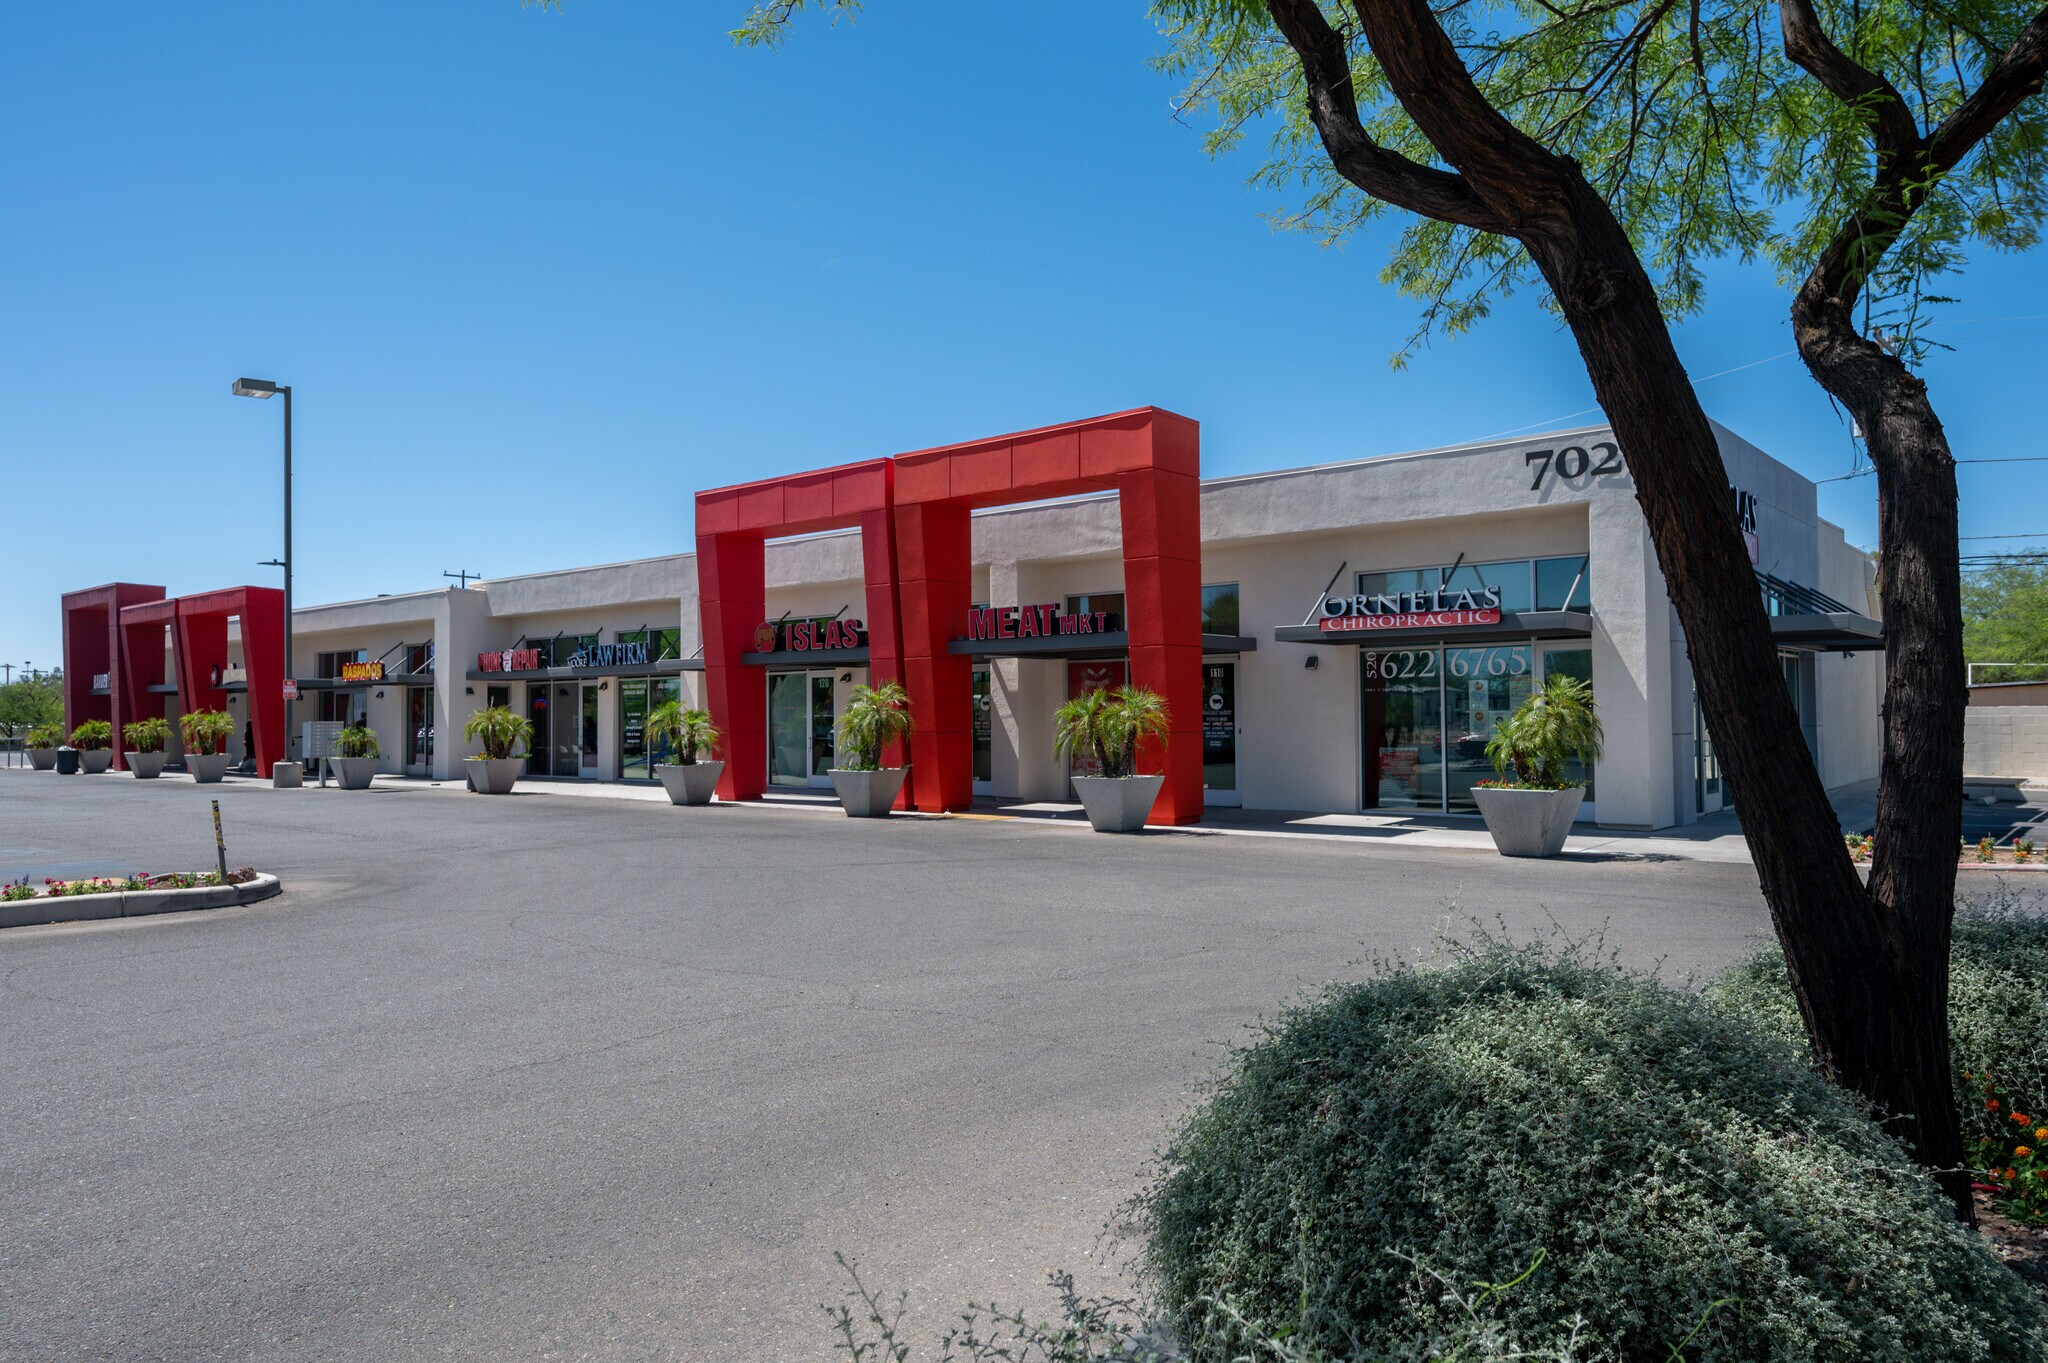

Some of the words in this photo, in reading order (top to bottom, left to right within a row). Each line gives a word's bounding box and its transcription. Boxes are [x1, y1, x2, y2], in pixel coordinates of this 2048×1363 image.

[1526, 442, 1622, 491] 702
[1321, 586, 1500, 618] ORNELAS
[968, 603, 1056, 641] MEAT
[1059, 612, 1107, 635] MKT
[1328, 609, 1491, 630] CHIROPRACTIC
[785, 619, 858, 652] ISLAS
[478, 651, 502, 672] PHONE
[512, 648, 539, 671] REPAIR
[567, 658, 587, 667] MOORE
[588, 644, 615, 667] LAW
[616, 641, 648, 665] FIRM
[1366, 651, 1378, 679] 520
[1380, 650, 1436, 679] 622
[1450, 646, 1527, 677] 6765
[342, 663, 383, 679] RASPADOS
